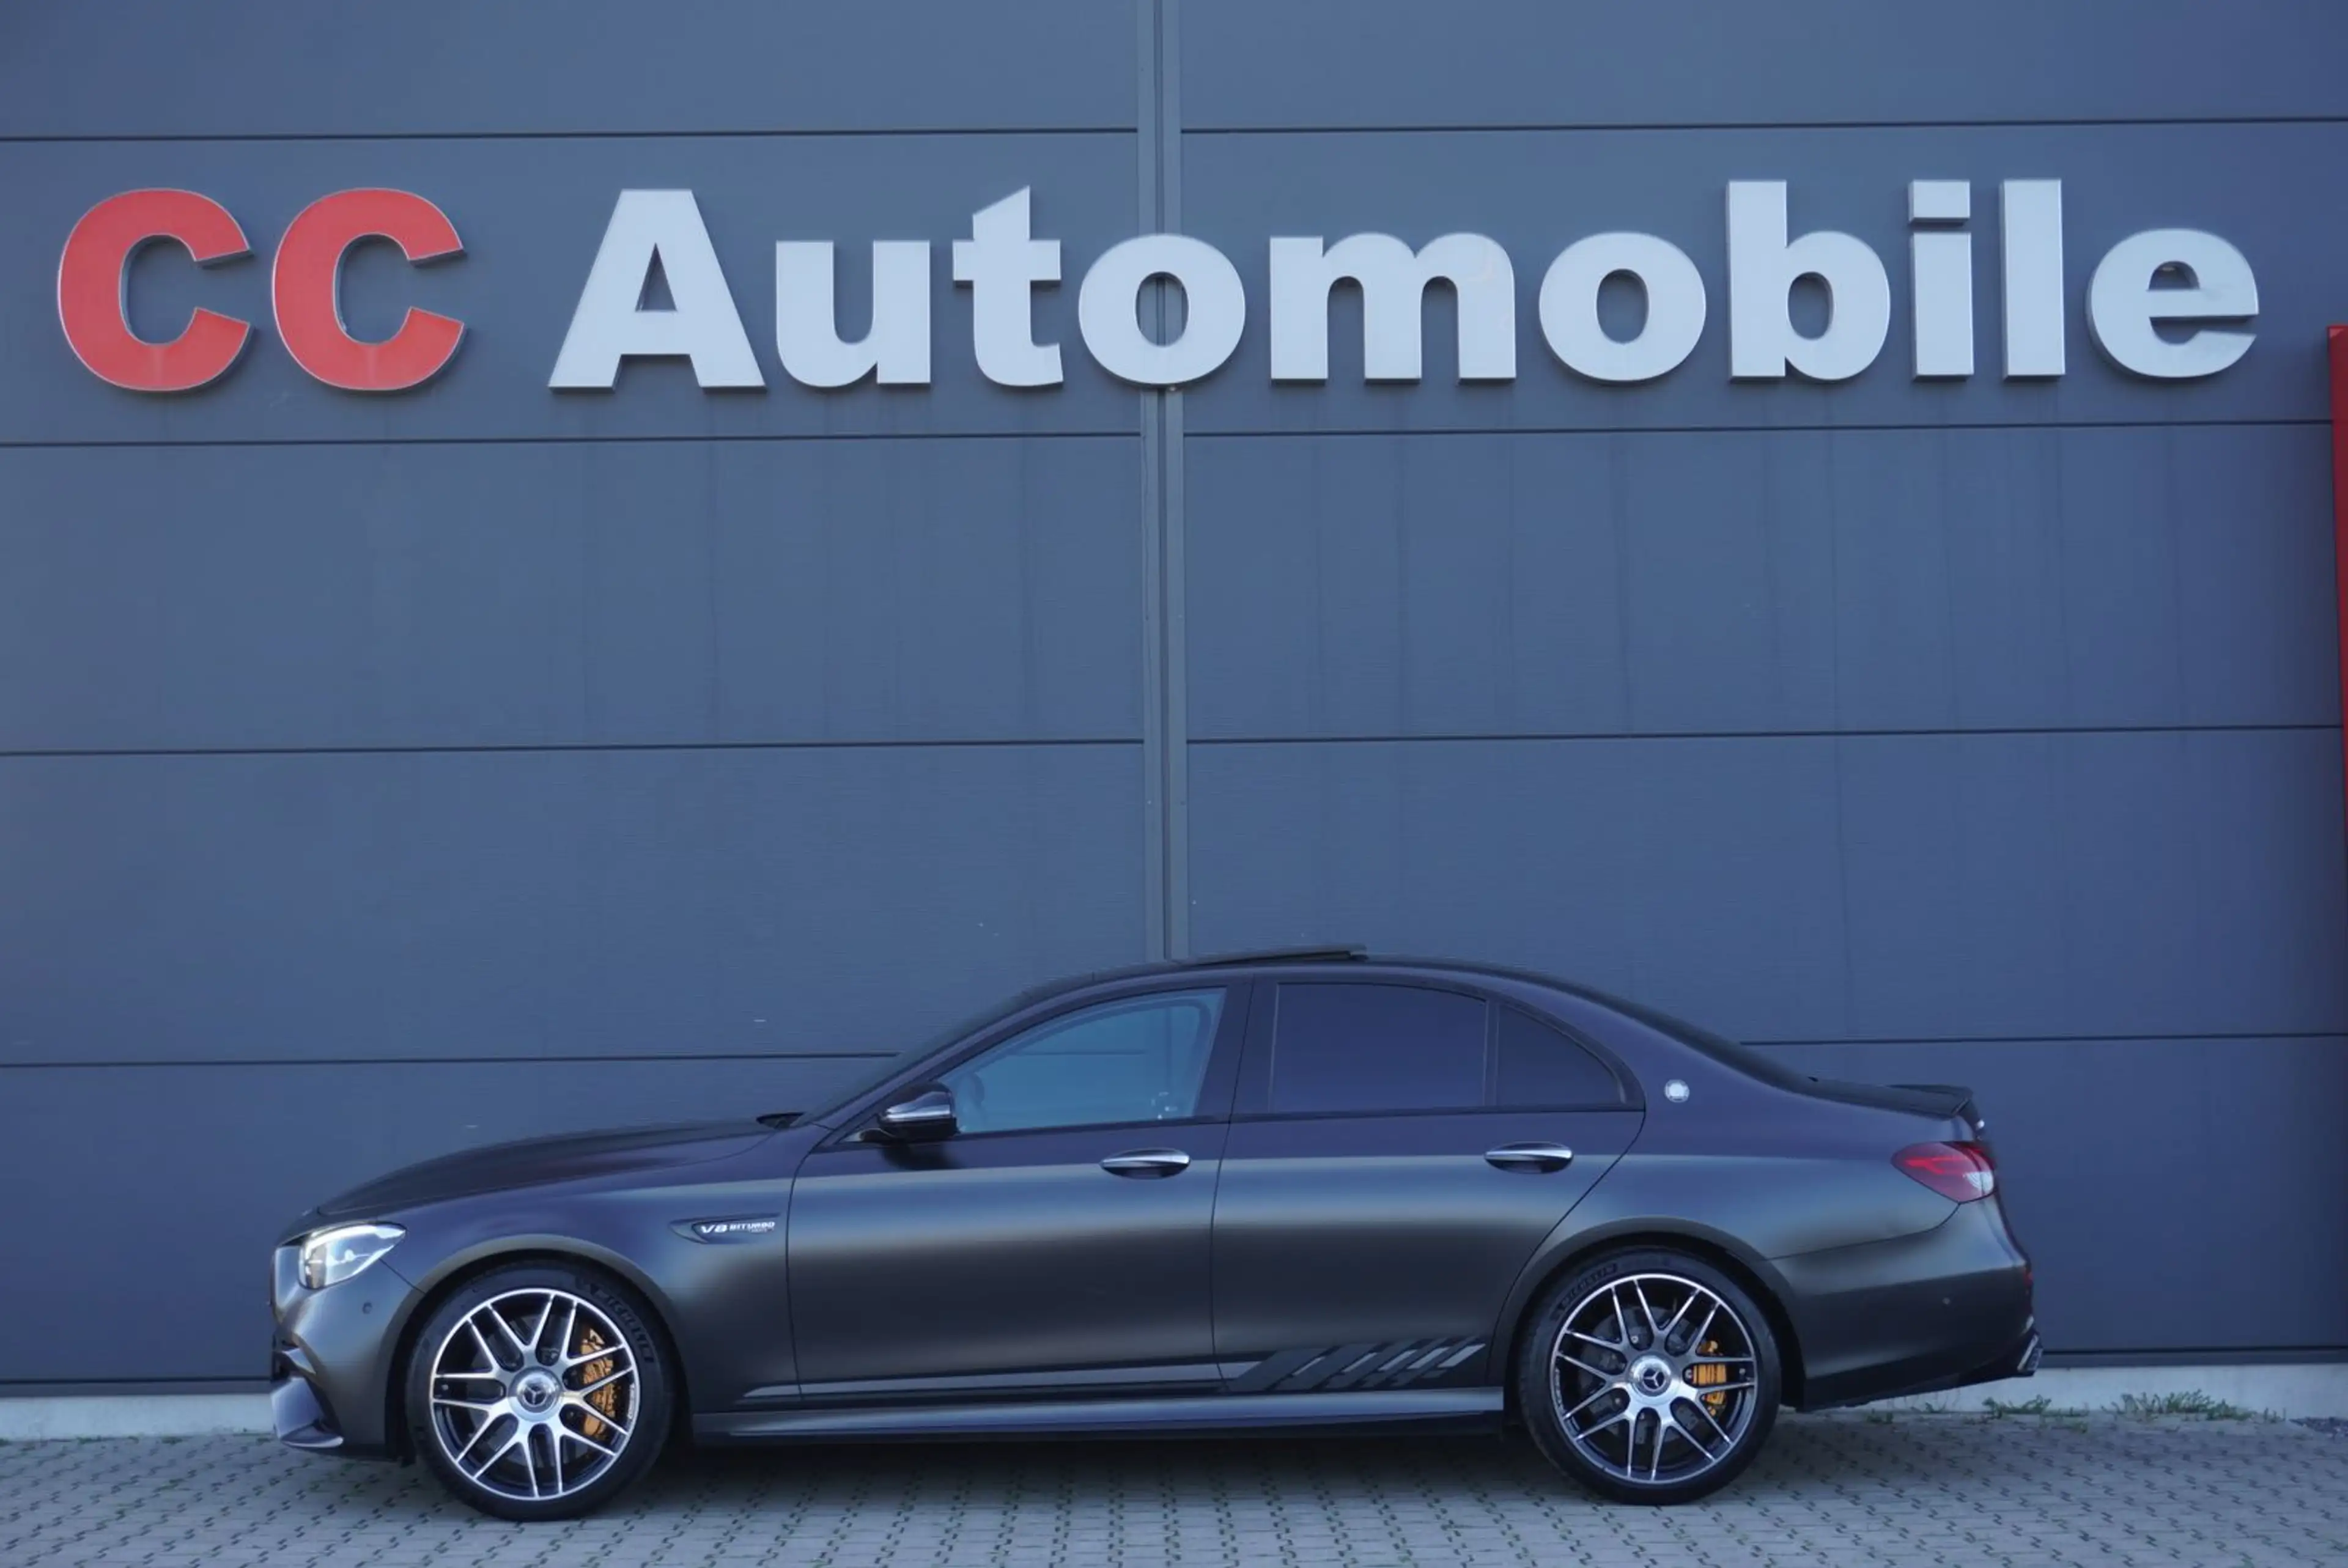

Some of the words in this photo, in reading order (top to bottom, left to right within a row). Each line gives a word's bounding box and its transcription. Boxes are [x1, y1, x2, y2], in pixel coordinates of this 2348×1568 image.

[57, 188, 467, 393] CC
[548, 179, 2259, 391] Automobile
[701, 1224, 728, 1234] V8
